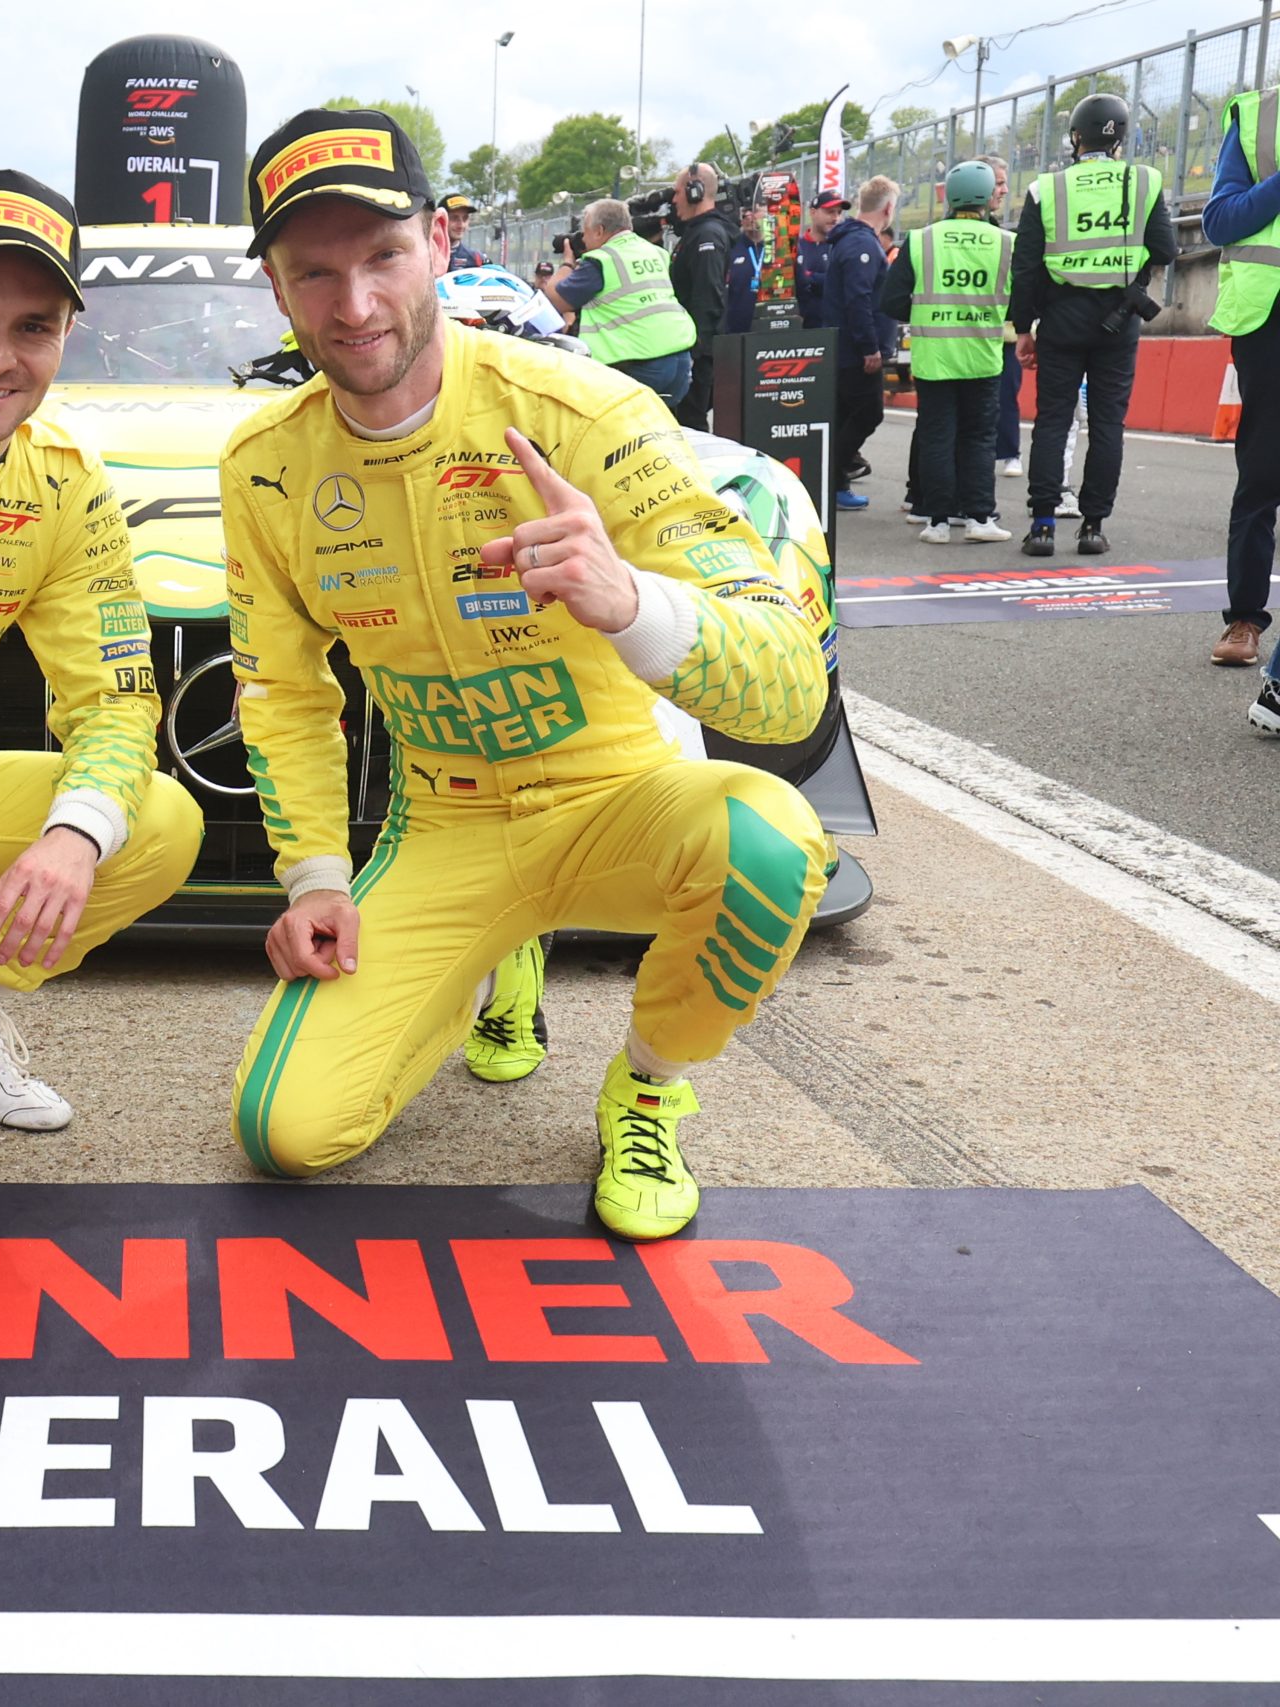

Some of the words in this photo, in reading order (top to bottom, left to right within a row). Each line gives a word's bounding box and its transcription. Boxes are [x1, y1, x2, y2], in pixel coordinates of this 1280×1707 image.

[126, 78, 199, 89] FANATEC
[126, 89, 198, 110] GT
[151, 111, 188, 119] CHALLENGE
[149, 126, 174, 136] aws
[127, 156, 187, 174] OVERALL
[265, 136, 381, 200] PIRELLI
[141, 181, 174, 224] 1
[1076, 210, 1130, 233] 544
[632, 259, 664, 275] 505
[1062, 256, 1088, 267] PIT
[1092, 256, 1133, 267] LANE
[942, 268, 988, 288] 590
[931, 311, 953, 321] PIT
[956, 311, 992, 321] LANE
[756, 347, 825, 360] FANATEC
[757, 357, 823, 378] GT
[782, 376, 815, 384] CHALLENGE
[780, 390, 804, 400] aws
[771, 423, 808, 439] SILVER
[437, 466, 526, 491] GT
[443, 492, 470, 504] WORLD
[629, 476, 692, 518] WACKE
[474, 508, 508, 522] aws
[85, 533, 131, 558] WACKE
[332, 538, 383, 554] AMG
[690, 539, 748, 563] MANN
[359, 574, 401, 588] RACING
[102, 604, 143, 619] MANN
[465, 599, 521, 614] BILSTEIN
[105, 618, 146, 634] FILTER
[332, 608, 398, 628] PIRELLI
[489, 624, 540, 644] IWC
[380, 666, 562, 721] MANN
[393, 701, 574, 756] FILTER
